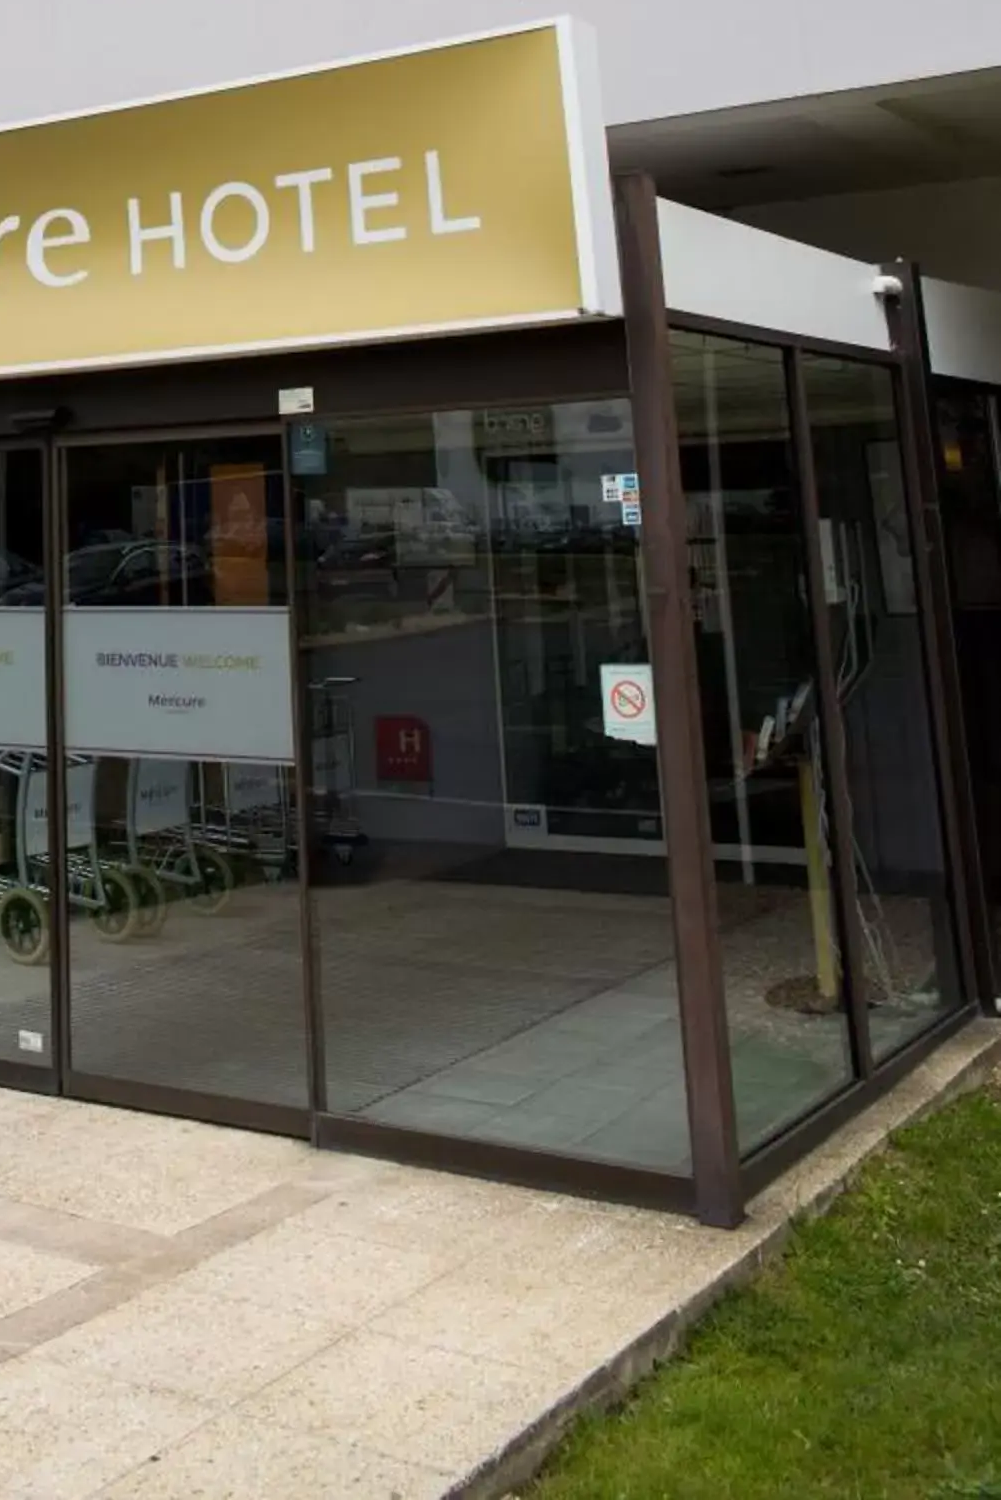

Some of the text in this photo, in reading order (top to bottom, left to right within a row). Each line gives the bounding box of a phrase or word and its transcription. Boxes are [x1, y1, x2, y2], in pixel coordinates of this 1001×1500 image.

[128, 150, 482, 282] HOTEL
[96, 653, 260, 670] BIENVENUE WELCOME
[148, 694, 205, 708] Mercure
